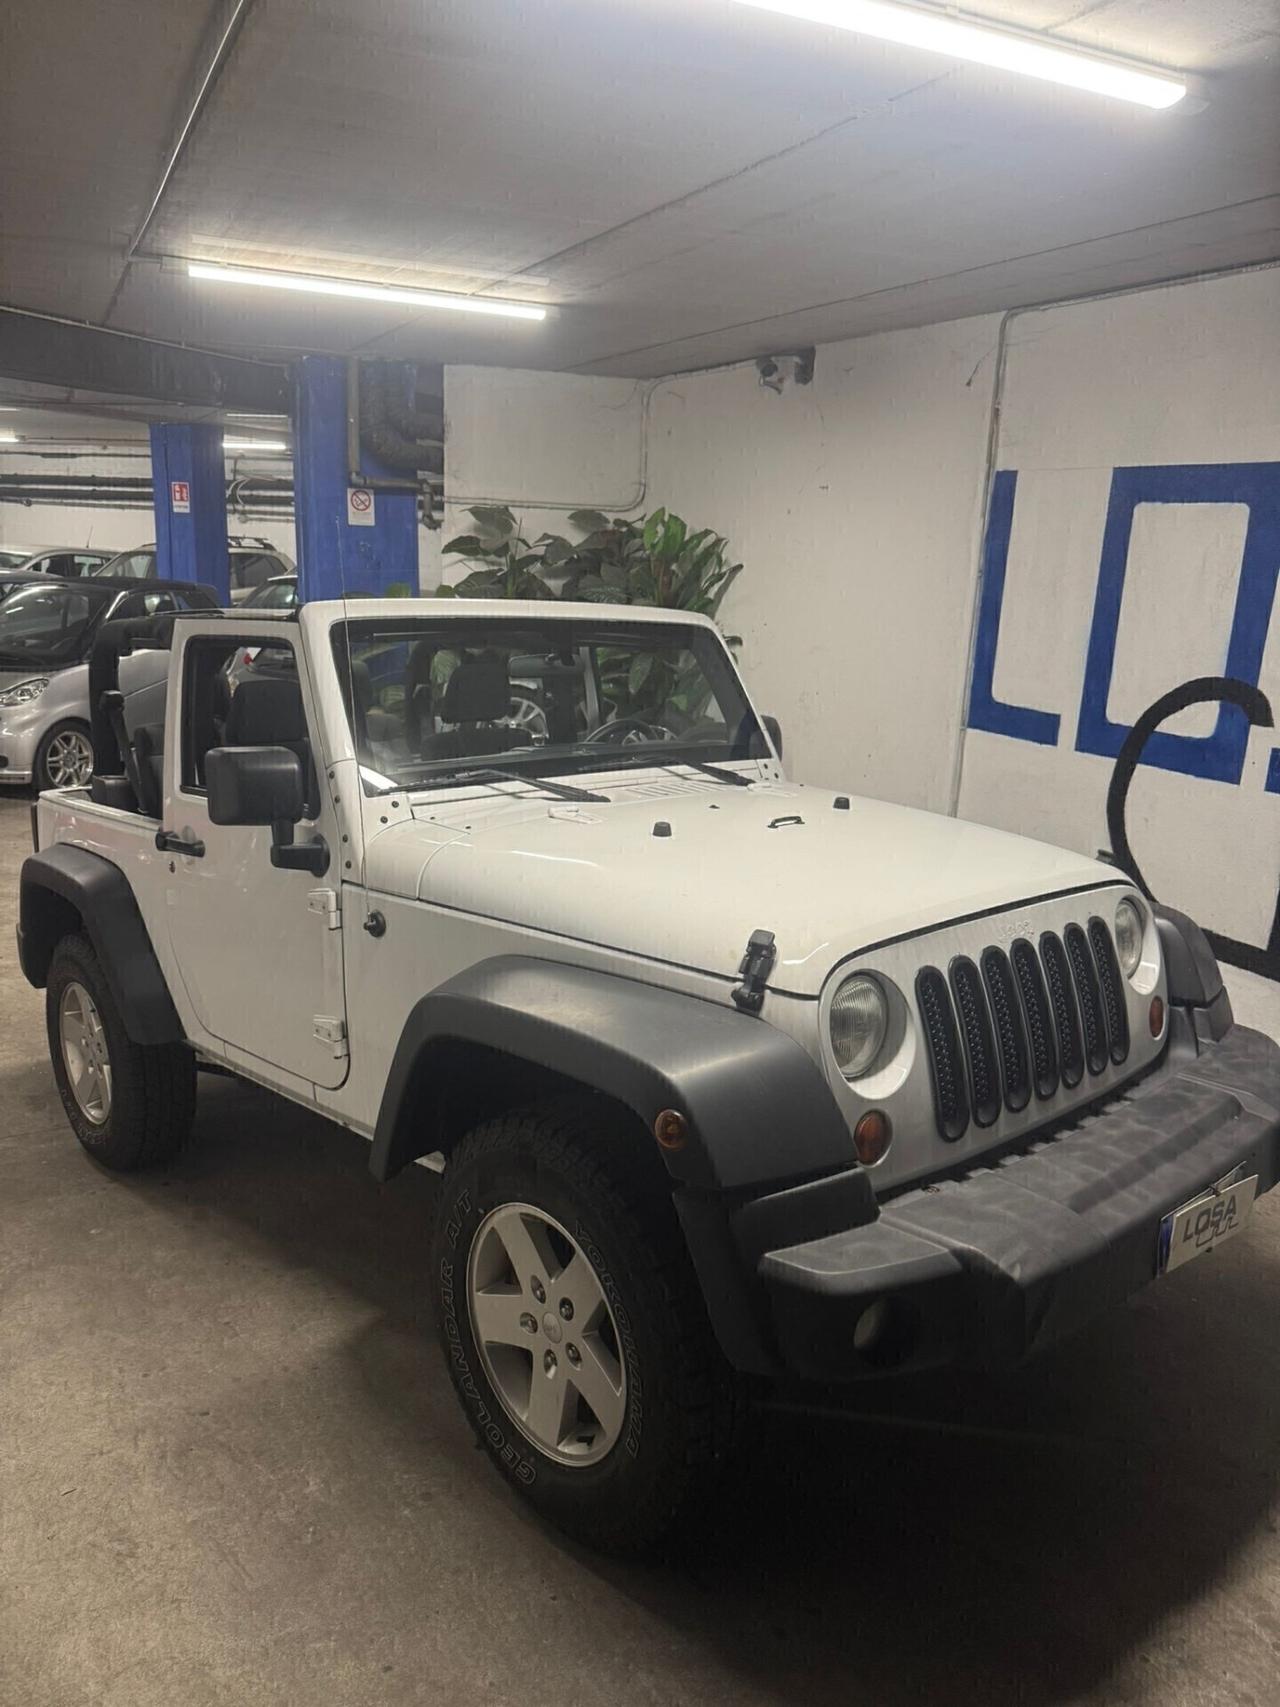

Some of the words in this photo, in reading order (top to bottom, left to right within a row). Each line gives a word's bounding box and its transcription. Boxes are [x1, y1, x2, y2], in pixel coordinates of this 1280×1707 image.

[967, 460, 1280, 796] LO
[1182, 1194, 1237, 1243] LOSA
[440, 1257, 537, 1485] GEOLANDAR
[575, 1220, 642, 1459] YOKOHAMA
